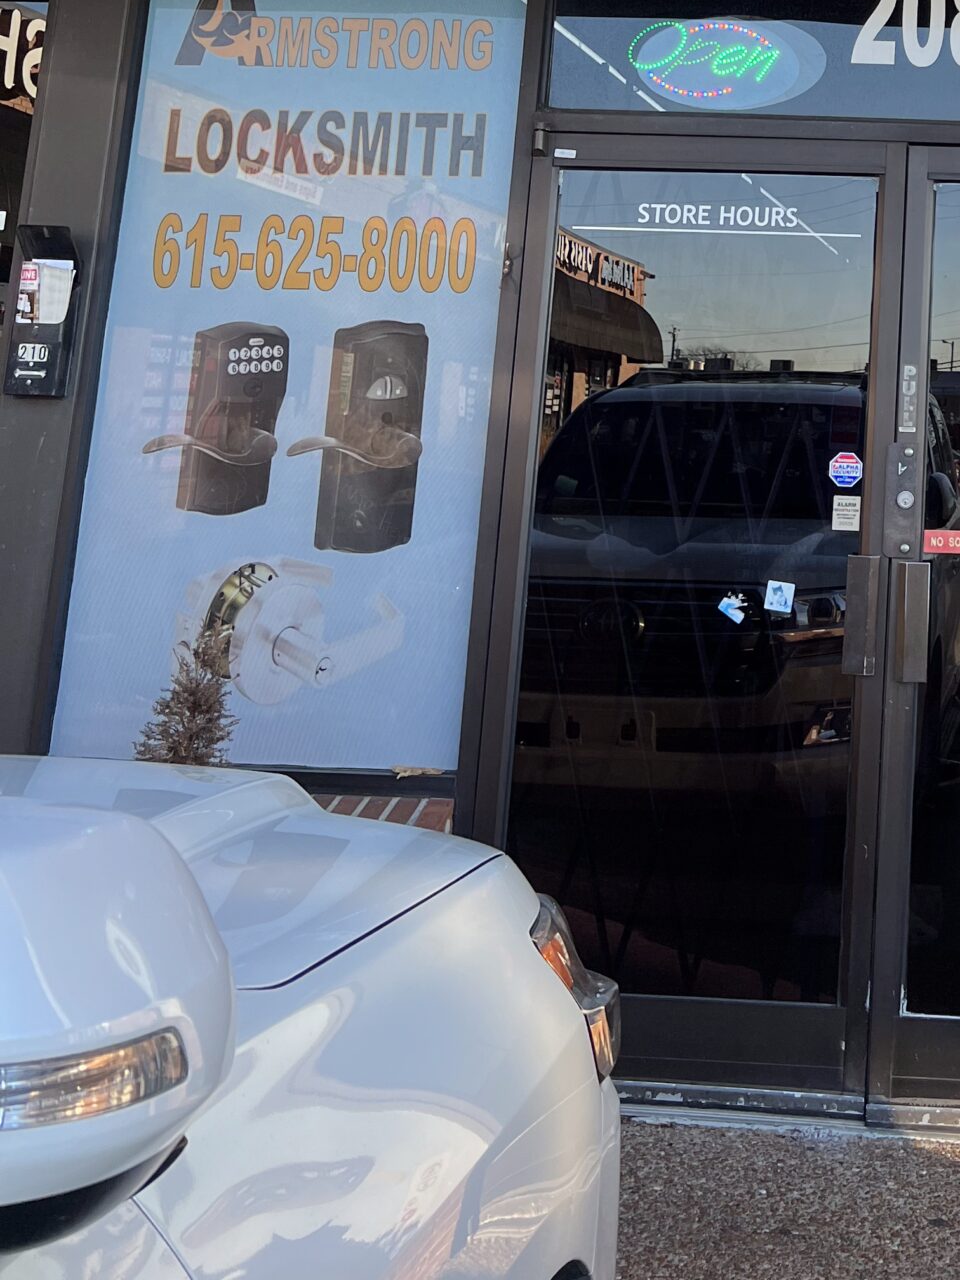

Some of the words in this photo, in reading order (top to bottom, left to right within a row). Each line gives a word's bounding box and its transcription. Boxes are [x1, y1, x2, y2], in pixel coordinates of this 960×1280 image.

[162, 108, 487, 178] LOCKSMITH
[637, 202, 711, 226] STORE
[719, 205, 799, 228] HOURS
[153, 212, 478, 294] 615-625-8000
[18, 344, 48, 361] 210
[930, 536, 944, 547] NO
